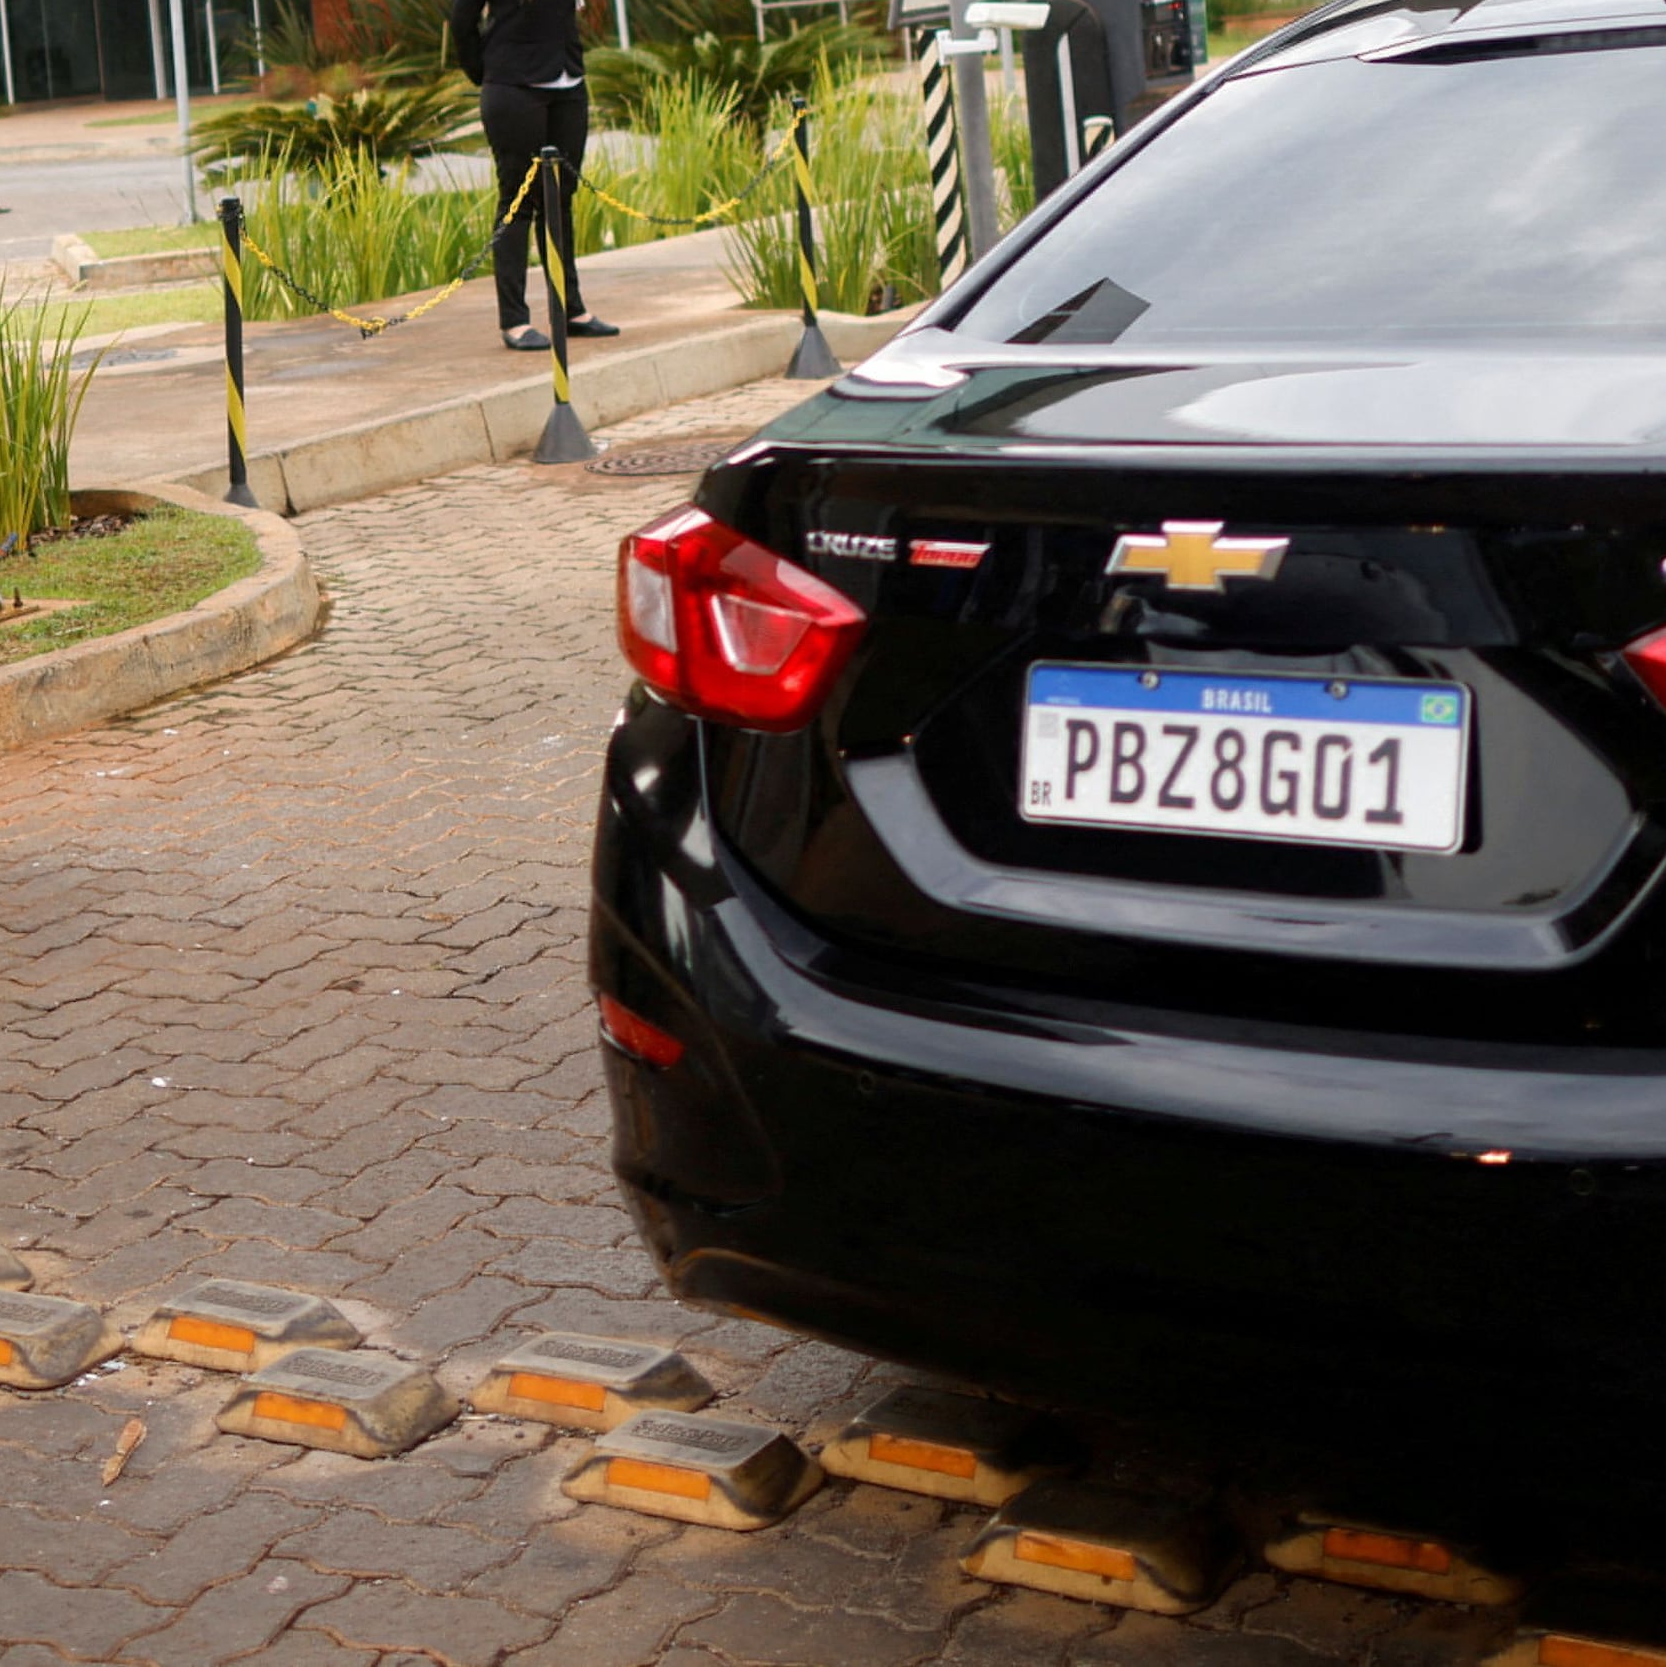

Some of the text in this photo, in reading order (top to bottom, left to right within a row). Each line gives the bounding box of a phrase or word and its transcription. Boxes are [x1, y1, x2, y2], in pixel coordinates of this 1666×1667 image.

[1201, 687, 1273, 714] BRASIL
[1064, 718, 1405, 826] PBZ8G01
[1030, 780, 1053, 807] BR
